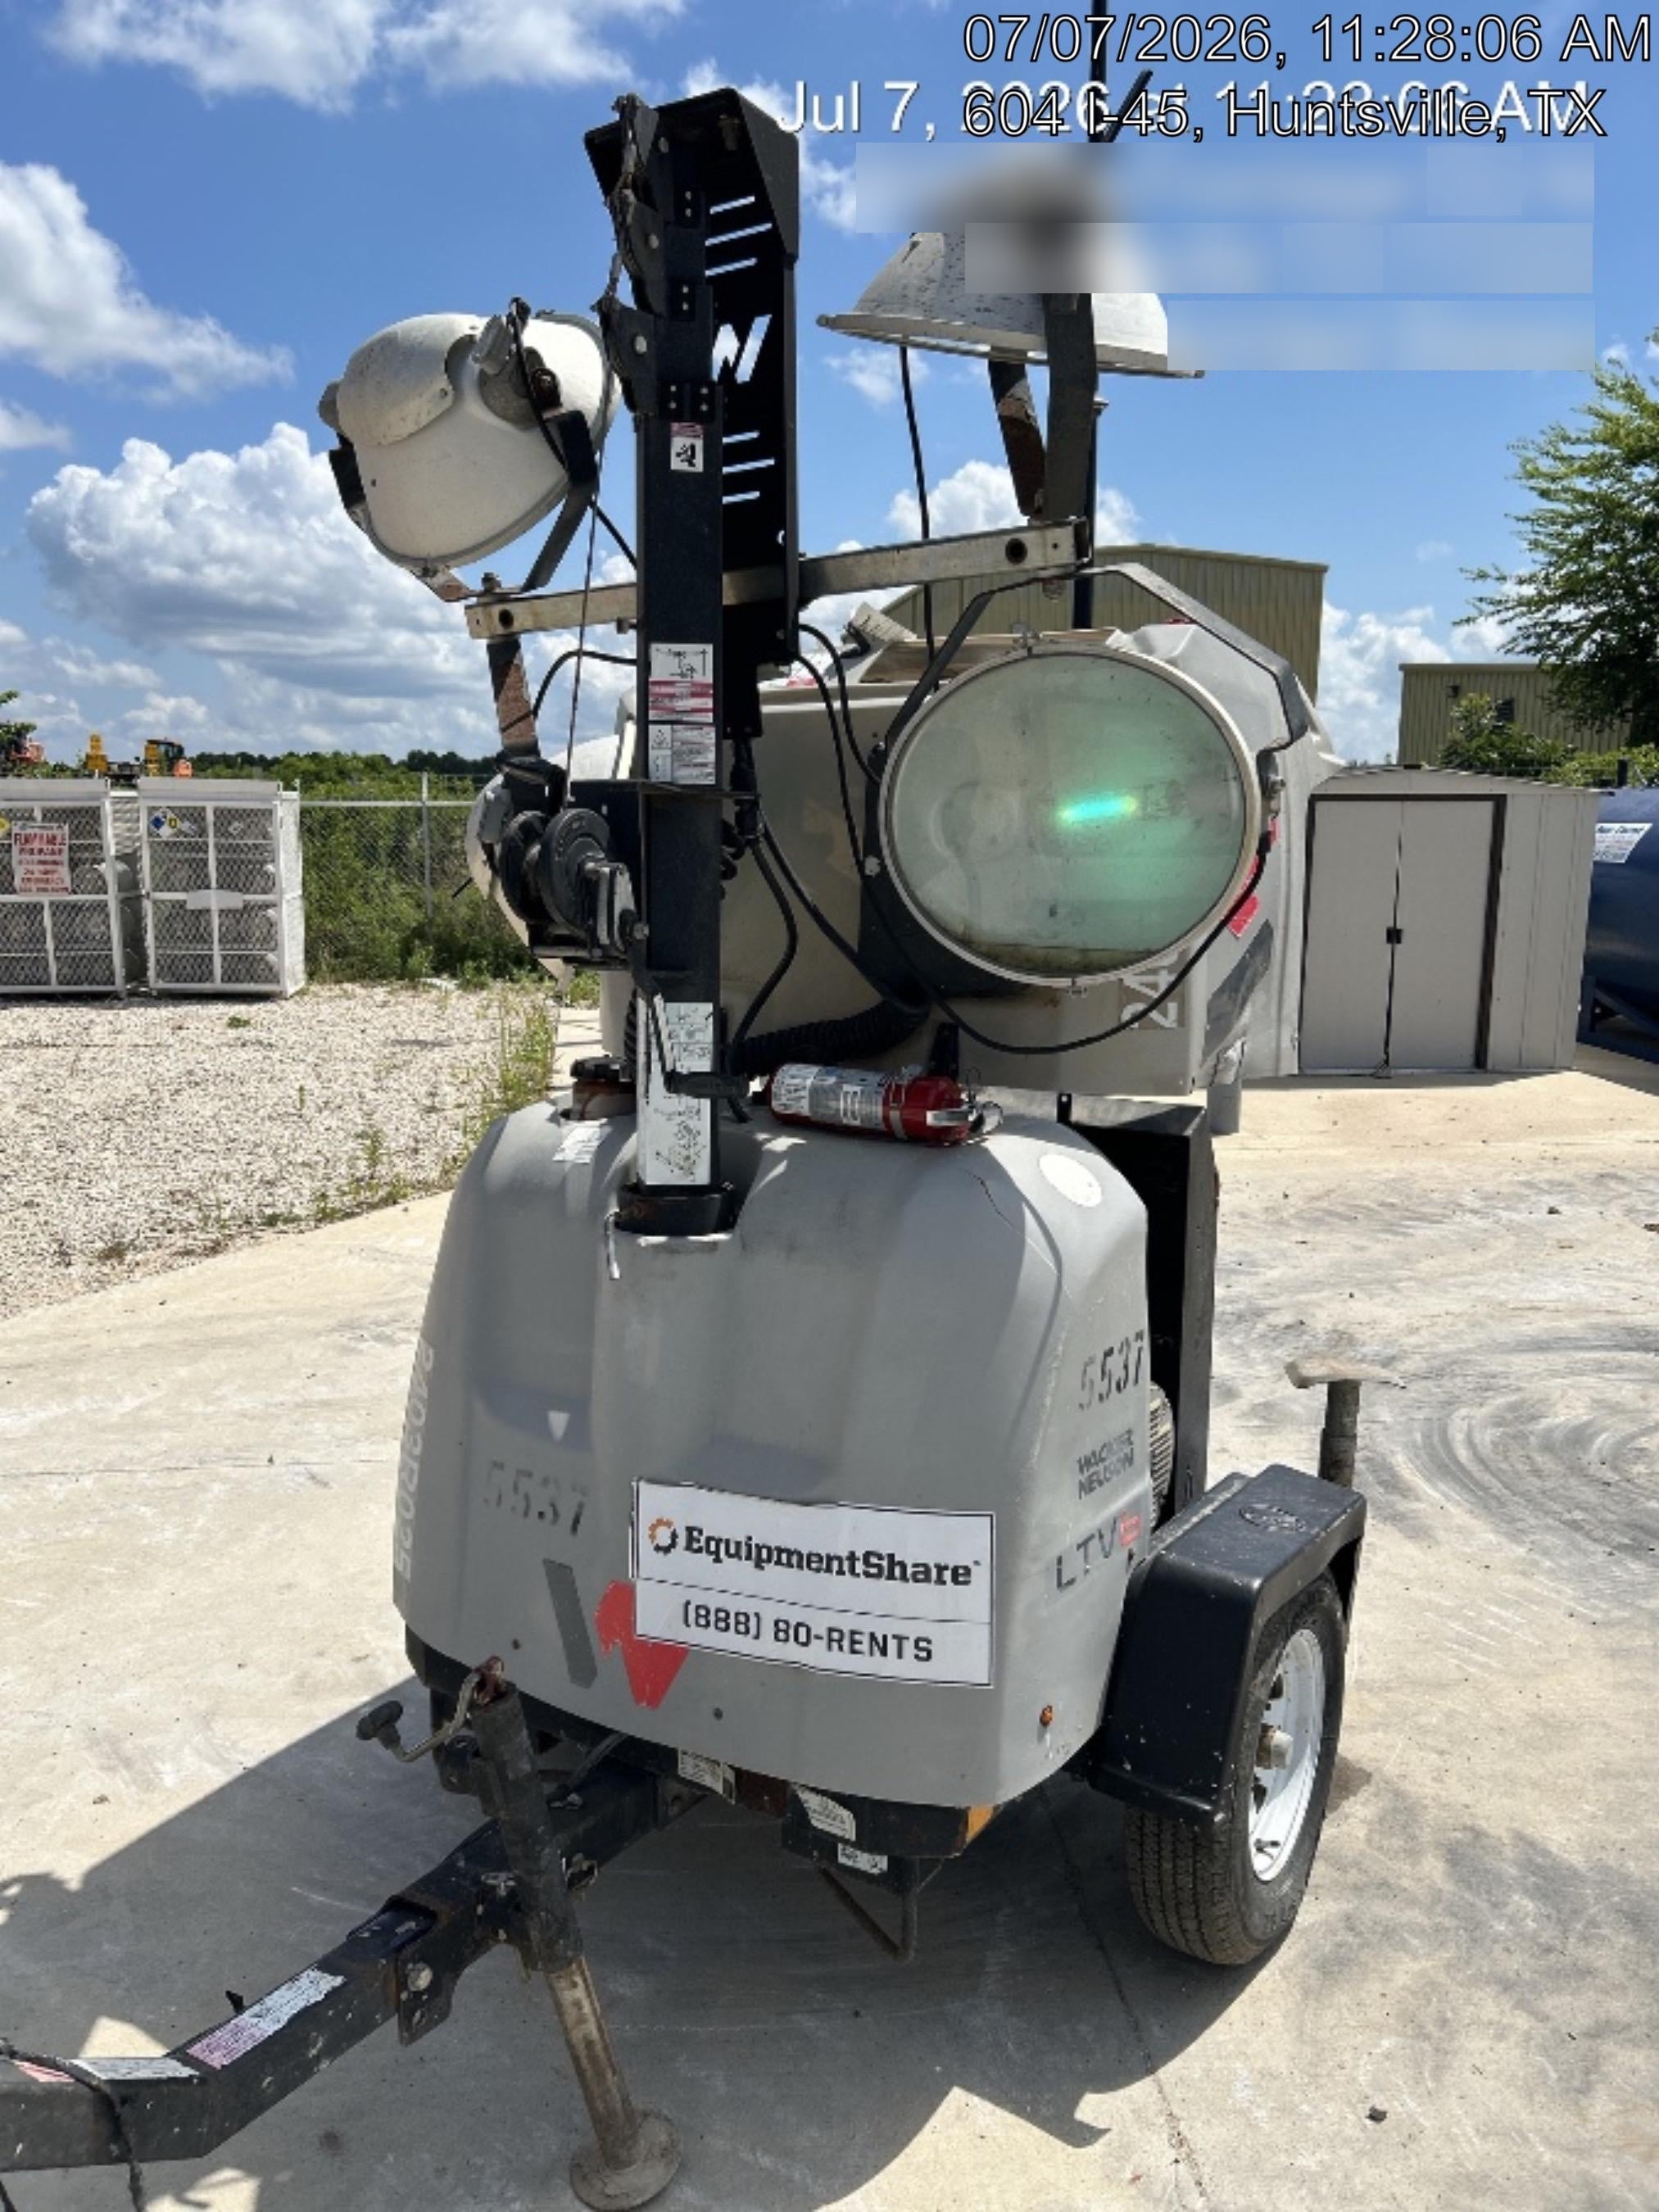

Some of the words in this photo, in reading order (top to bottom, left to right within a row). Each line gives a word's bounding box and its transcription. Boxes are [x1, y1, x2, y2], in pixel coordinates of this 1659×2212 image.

[682, 1525, 973, 1588] EquipmentShare
[682, 1599, 763, 1641] (888)
[773, 1618, 934, 1663] 80-RENTS
